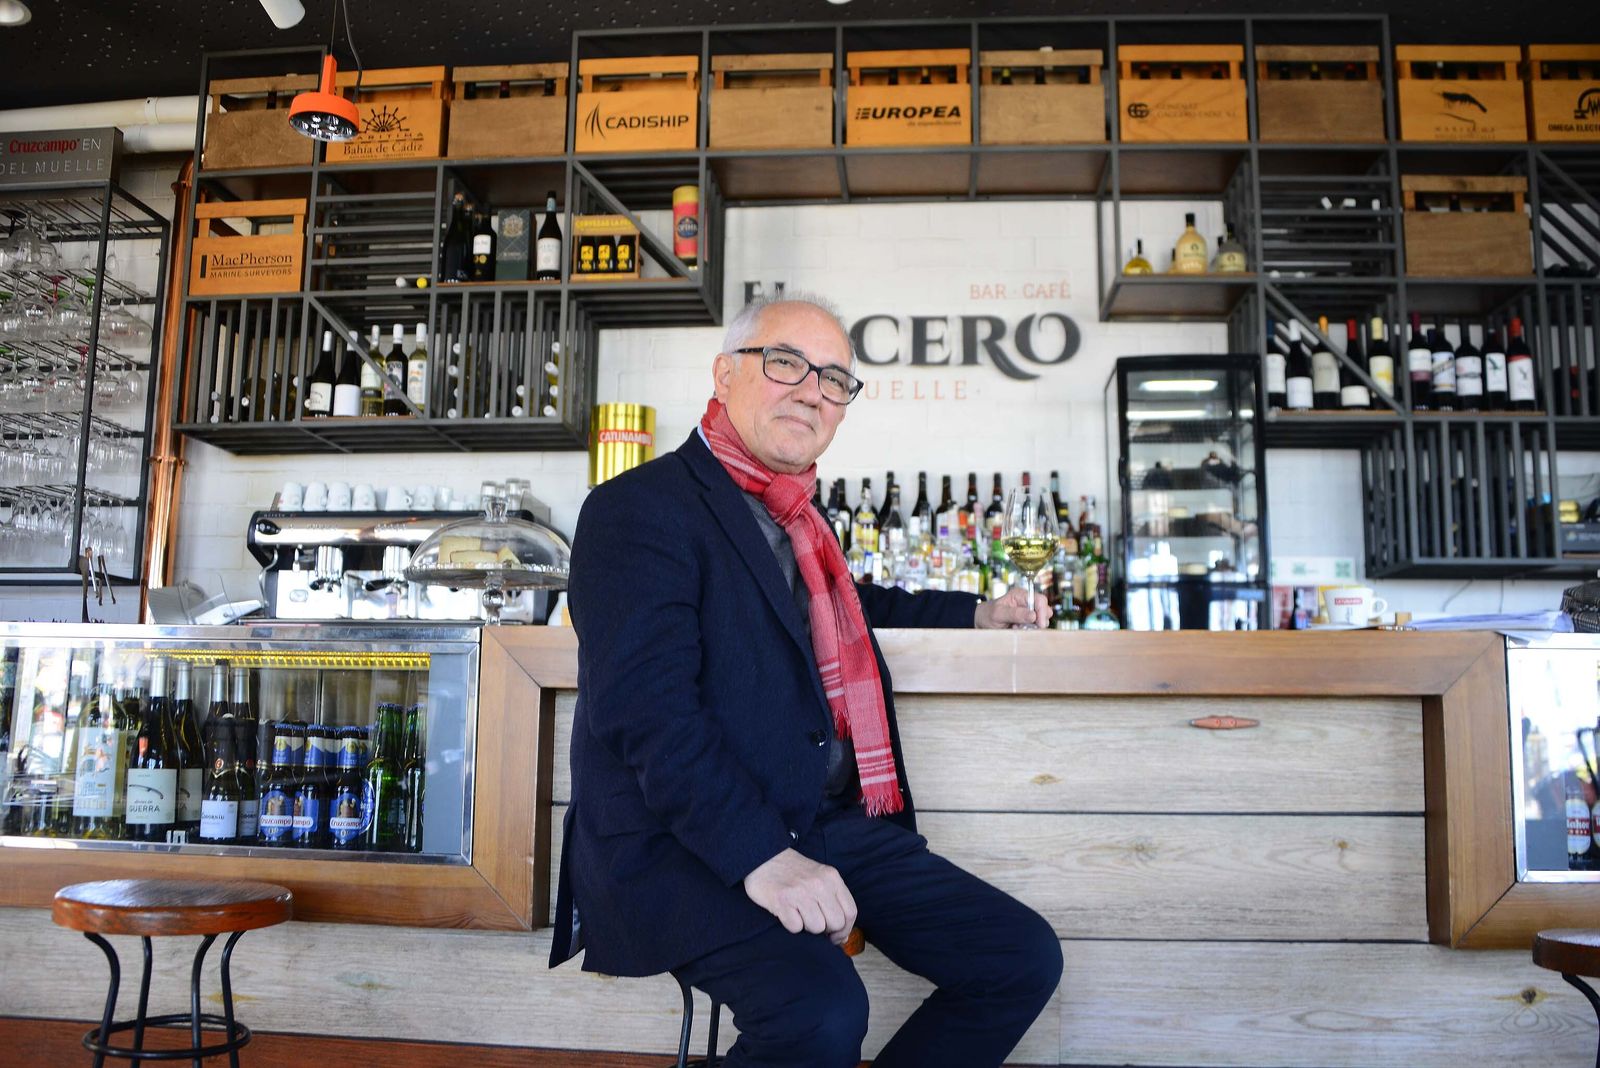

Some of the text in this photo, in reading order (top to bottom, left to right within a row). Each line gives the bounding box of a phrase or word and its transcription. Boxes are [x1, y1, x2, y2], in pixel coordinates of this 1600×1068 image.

[856, 105, 961, 119] EUROPEA
[605, 115, 689, 129] CADISHIP
[1548, 124, 1574, 132] OMEGA
[9, 138, 77, 154] Cruzcampo
[82, 138, 101, 151] EN
[376, 142, 389, 152] de
[35, 158, 105, 174] MUELLE
[211, 252, 292, 266] MacPherson
[209, 268, 293, 279] MARINE SURVEYORS
[970, 281, 1071, 299] BAR CAFÉ
[850, 312, 1081, 381] CERO
[865, 380, 968, 400] UELLE
[128, 804, 161, 813] GUERRA
